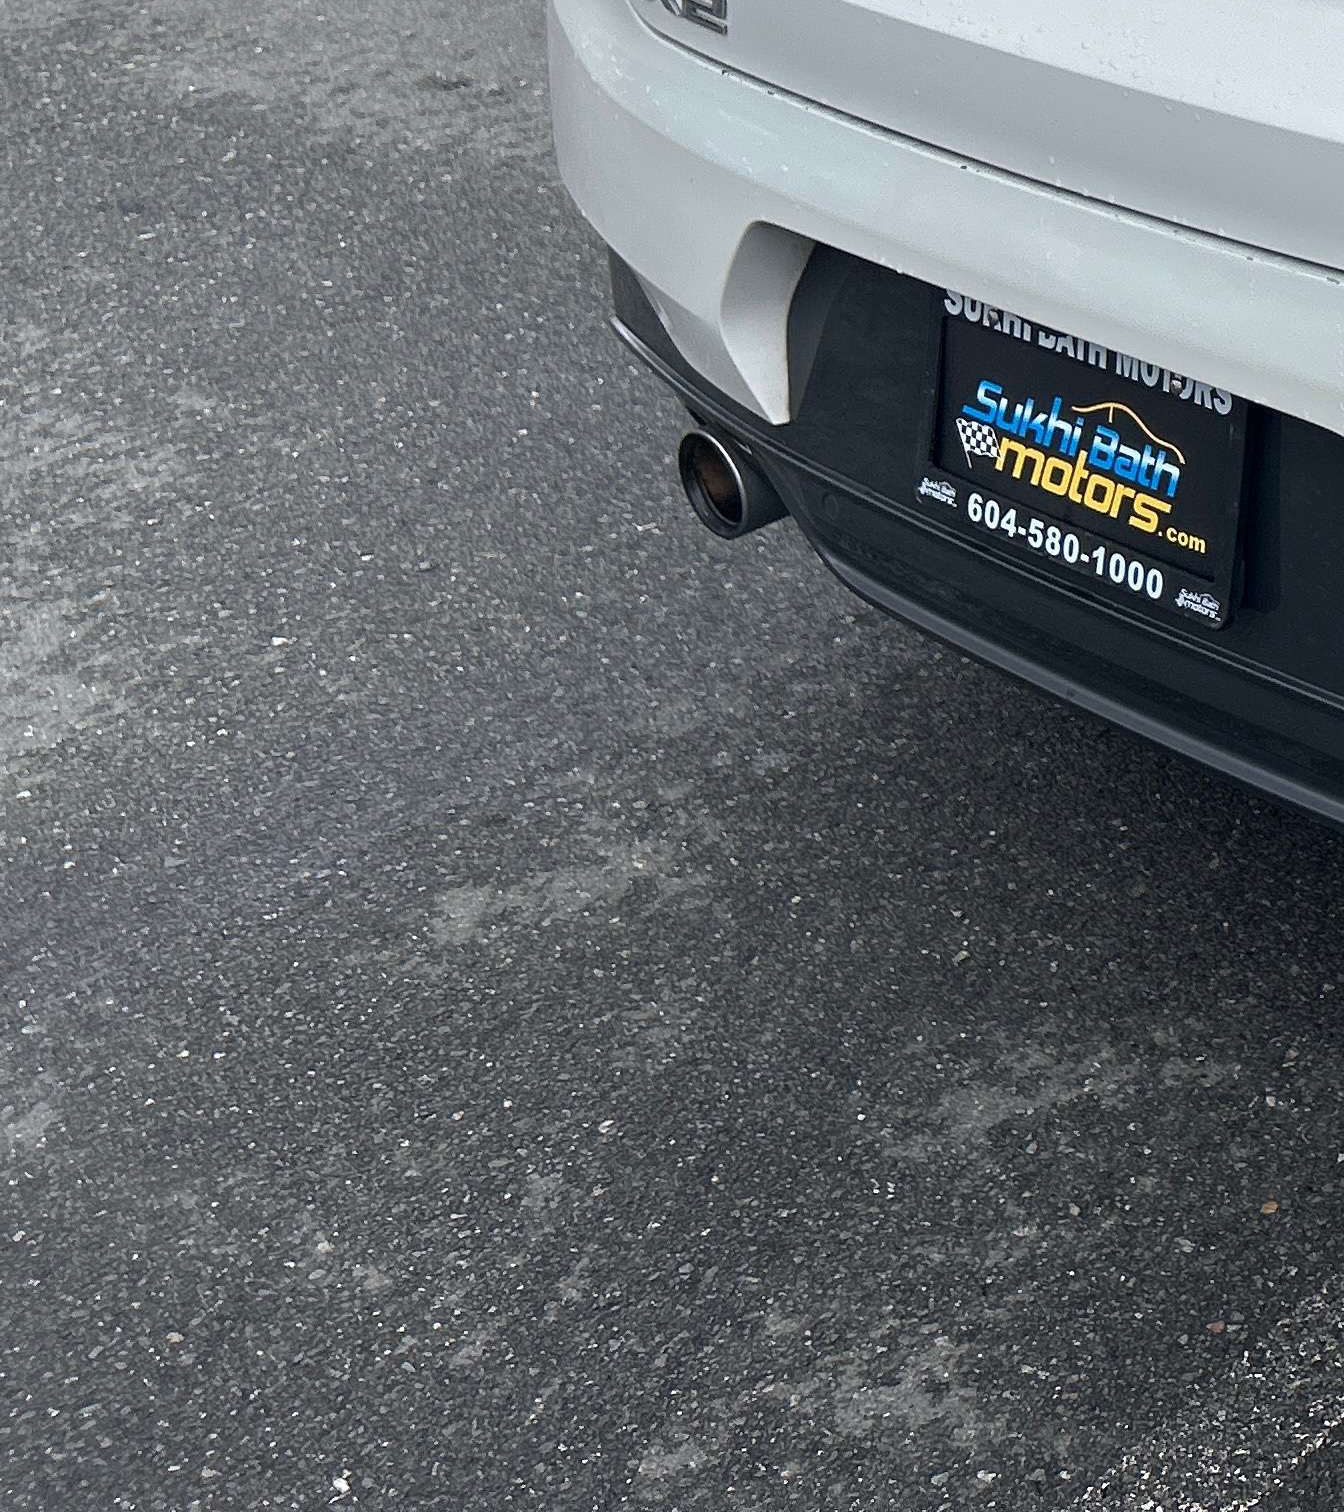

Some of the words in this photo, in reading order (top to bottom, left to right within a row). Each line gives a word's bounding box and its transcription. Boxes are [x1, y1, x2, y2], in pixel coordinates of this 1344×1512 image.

[962, 379, 1084, 457] Sukhi
[1088, 424, 1182, 499] Bath
[967, 492, 1164, 600] 604-580-1000
